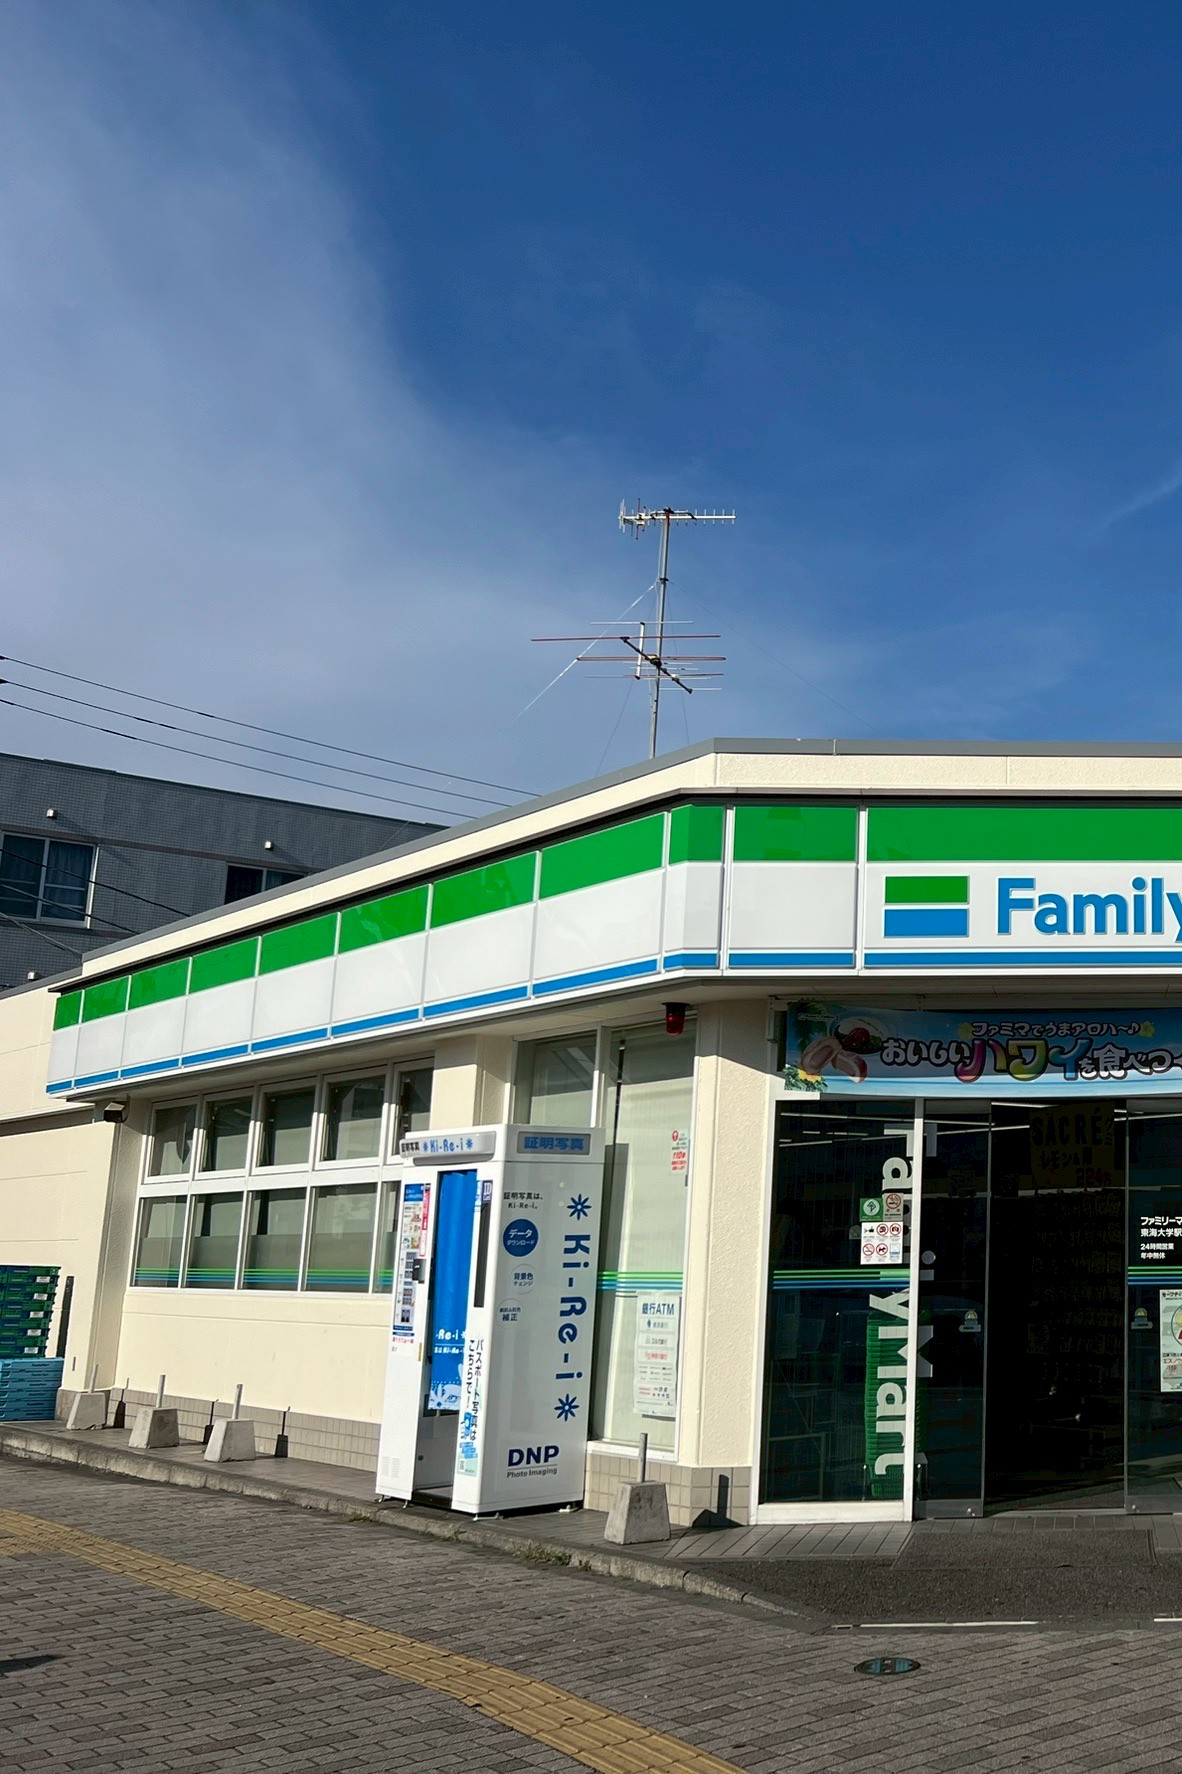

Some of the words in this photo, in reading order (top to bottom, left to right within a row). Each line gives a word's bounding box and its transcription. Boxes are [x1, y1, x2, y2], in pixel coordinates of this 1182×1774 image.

[430, 1137, 464, 1153] Ki-Re-i
[523, 1136, 585, 1151] 証明写真
[508, 1228, 533, 1238] データ
[555, 1234, 591, 1380] Ki-Re-i
[508, 1445, 560, 1467] DNP
[506, 1470, 528, 1479] Photo
[528, 1467, 558, 1476] Imaging
